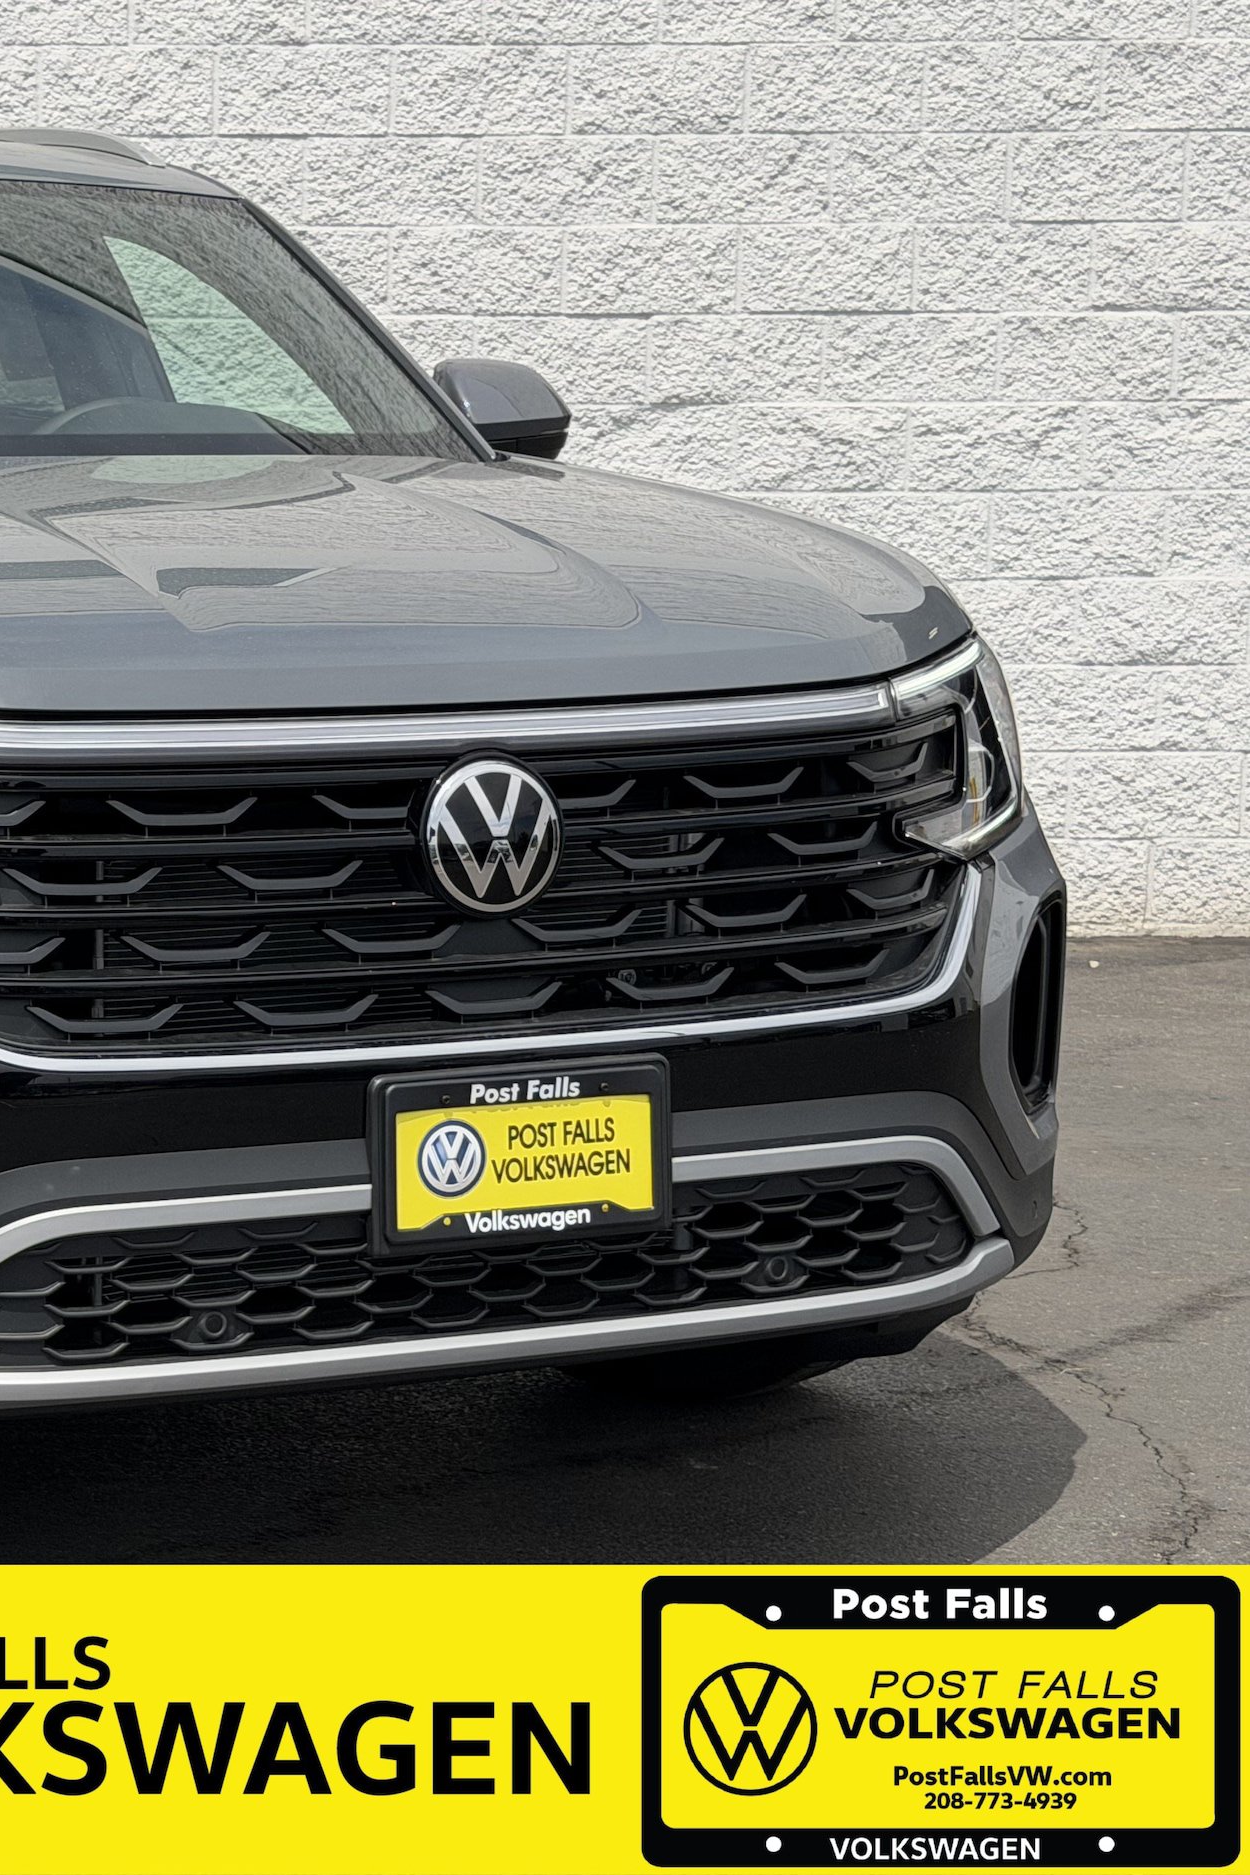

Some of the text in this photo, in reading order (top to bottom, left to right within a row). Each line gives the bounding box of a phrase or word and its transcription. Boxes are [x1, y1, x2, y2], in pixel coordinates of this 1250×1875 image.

[470, 1077, 581, 1105] Post Falls
[508, 1117, 616, 1150] POST FALLS
[491, 1149, 631, 1184] VOLKSWAGEN
[465, 1207, 591, 1233] Volkswagen
